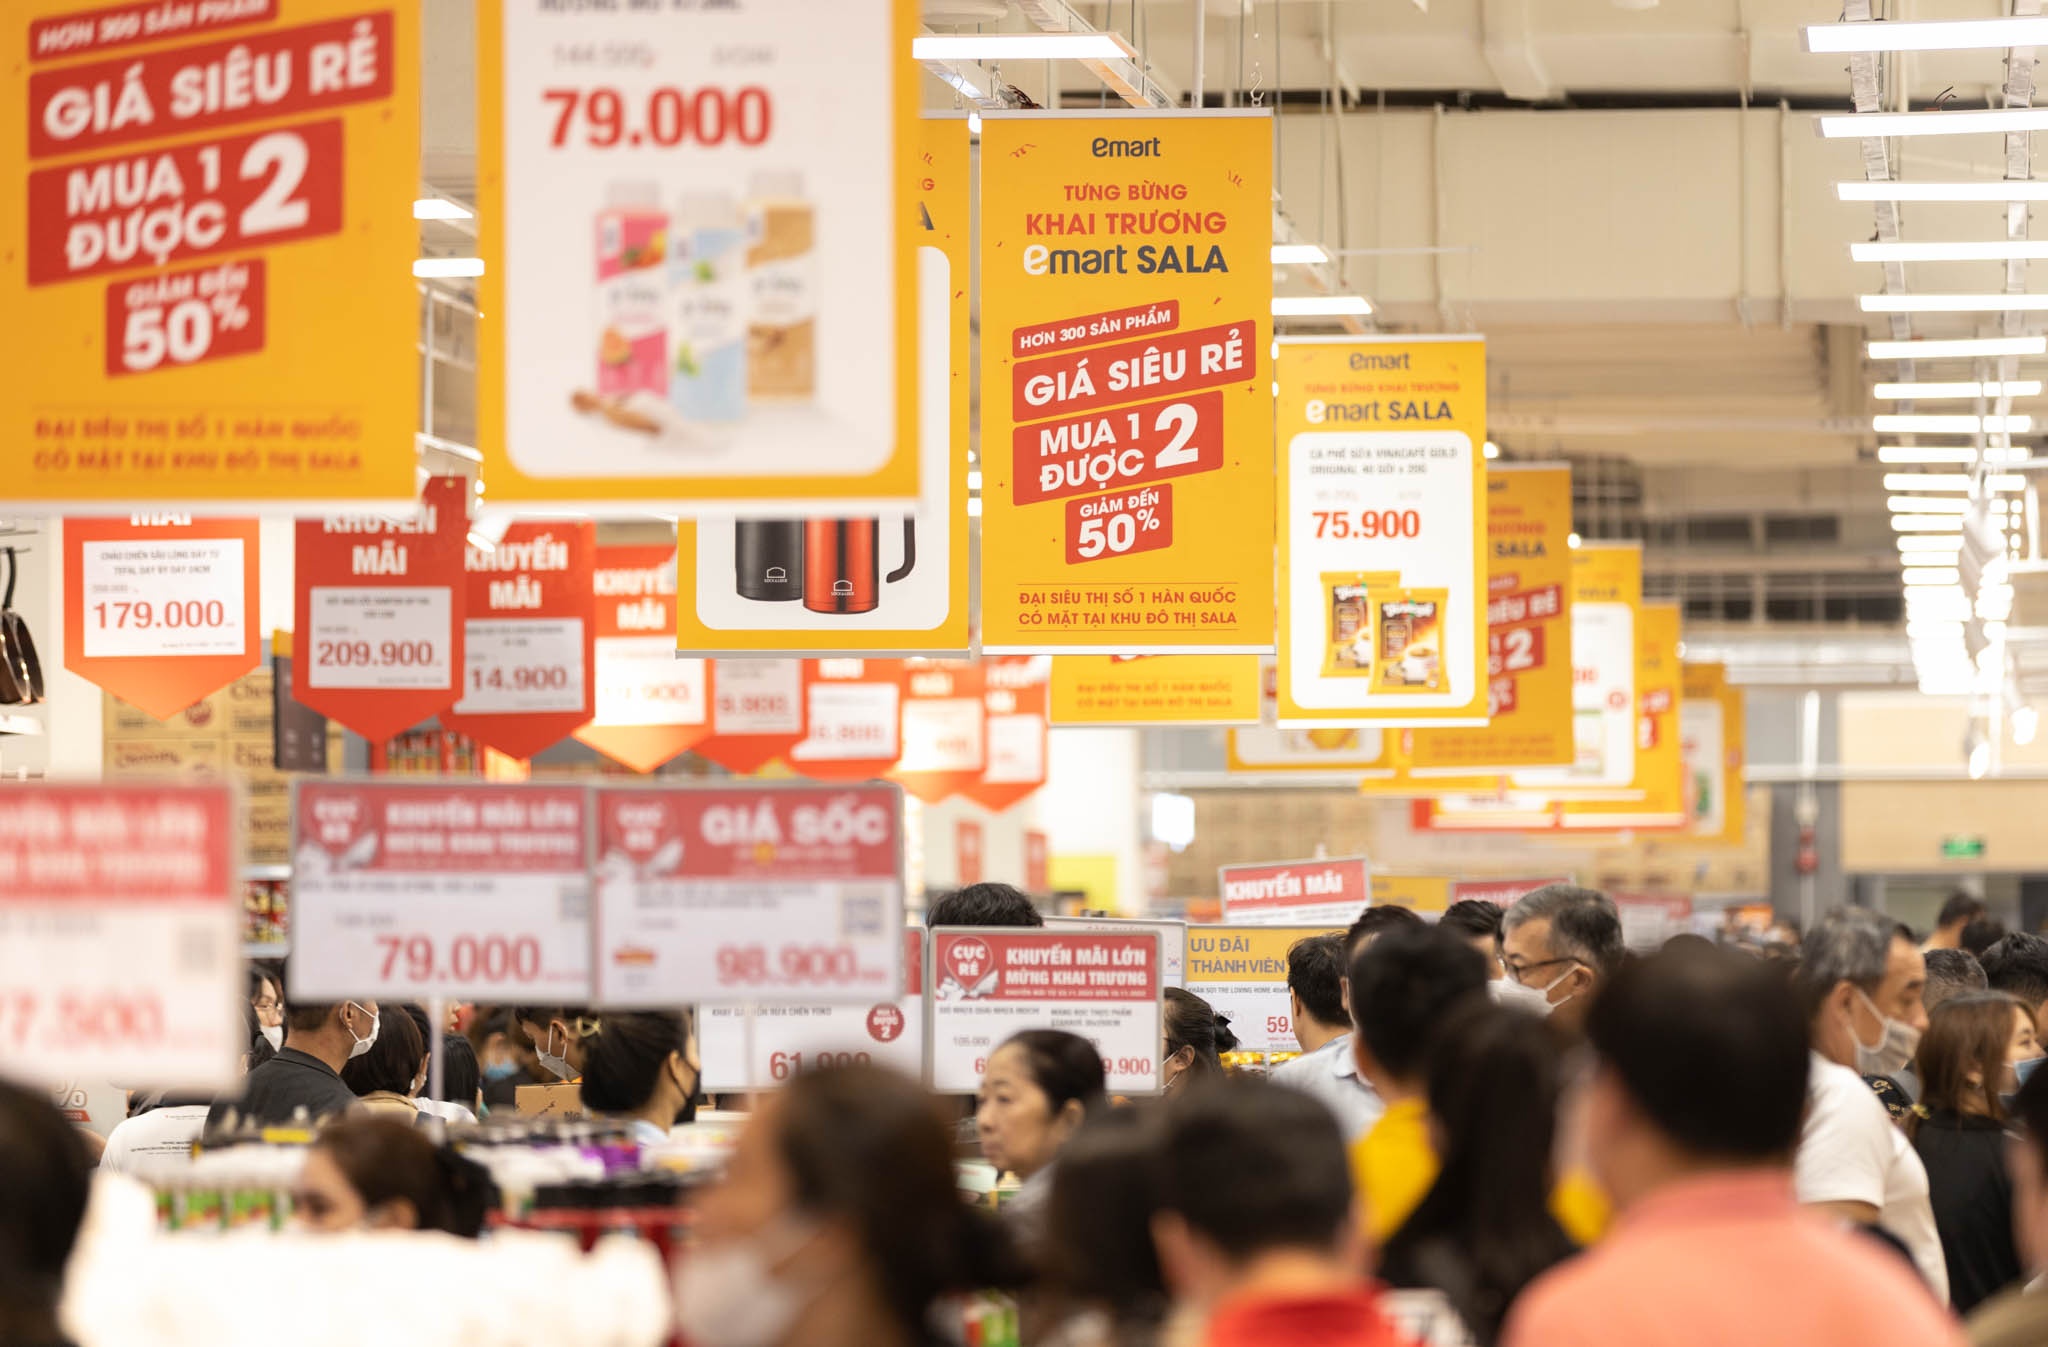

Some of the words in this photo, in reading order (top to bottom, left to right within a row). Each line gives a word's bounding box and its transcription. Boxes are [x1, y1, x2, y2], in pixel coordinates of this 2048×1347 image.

[43, 61, 155, 139] GIÁ
[169, 44, 292, 119] SIÊU
[309, 18, 378, 95] RẺ
[542, 85, 773, 149] 79.000
[1092, 137, 1161, 157] emart
[66, 153, 184, 216] MUA
[197, 145, 221, 193] 1
[238, 131, 310, 236] 2
[1064, 183, 1121, 201] TƯNG
[1128, 180, 1188, 201] BỪNG
[66, 200, 226, 270] ĐƯỢC
[1026, 213, 1095, 236] KHAI
[1106, 209, 1227, 235] TRƯƠNG
[1023, 244, 1128, 275] emart
[1137, 245, 1228, 273] SALA
[122, 292, 250, 371] 50%
[1020, 330, 1056, 349] HƠN
[1060, 325, 1086, 342] 300
[1090, 316, 1121, 337] SẢN
[1125, 305, 1171, 329] PHẨM
[1024, 358, 1096, 406] GIÁ
[1108, 346, 1187, 392] SIÊU
[1200, 328, 1243, 375] RẺ
[1350, 352, 1411, 371] emart
[1305, 399, 1380, 424] emart
[1389, 400, 1453, 421] SALA
[1040, 418, 1117, 457] MUA
[1127, 413, 1140, 440] 1
[1154, 403, 1199, 469] 2
[1039, 448, 1145, 492] ĐƯỢC
[1080, 497, 1123, 518] GIẢM
[1128, 487, 1160, 509] ĐẾN
[1077, 507, 1160, 558] 50%
[1312, 510, 1421, 539] 75.900
[353, 540, 407, 575] MÃI
[489, 575, 542, 609] MÃI
[1019, 592, 1045, 608] ĐẠI
[1050, 588, 1081, 604] SIÊU
[1087, 592, 1108, 608] THỊ
[1113, 587, 1134, 604] SỐ
[1139, 591, 1145, 603] 1
[1152, 587, 1185, 604] HÀN
[1189, 587, 1236, 604] QUỐC
[93, 600, 224, 629] 179.000
[1019, 609, 1042, 625] CÓ
[1048, 609, 1078, 627] MẶT
[1084, 613, 1105, 628] TẠI
[1111, 612, 1141, 625] KHU
[1146, 609, 1169, 624] ĐÔ
[1175, 612, 1196, 627] THỊ
[1200, 612, 1237, 624] SALA
[317, 641, 433, 667] 209.900
[1504, 629, 1534, 670] 2
[700, 797, 781, 846] GIÁ
[791, 794, 888, 845] SỐC
[1226, 871, 1301, 902] KHUYẾN
[1306, 869, 1343, 895] MÃI
[376, 933, 541, 983] 79.000
[952, 945, 986, 963] CỰC
[1006, 943, 1072, 967] KHUYẾN
[1076, 943, 1107, 967] MÃI
[1112, 944, 1147, 967] LỚN
[1190, 937, 1215, 953] ƯU
[1219, 935, 1250, 953] ĐÃI
[958, 961, 979, 977] RẺ
[1005, 968, 1049, 986] MỪNG
[1053, 971, 1085, 986] KHAI
[1089, 970, 1147, 986] TRƯƠNG
[1191, 956, 1247, 974] THÀNH
[1249, 956, 1285, 973] VIÊN
[881, 1026, 891, 1039] 2
